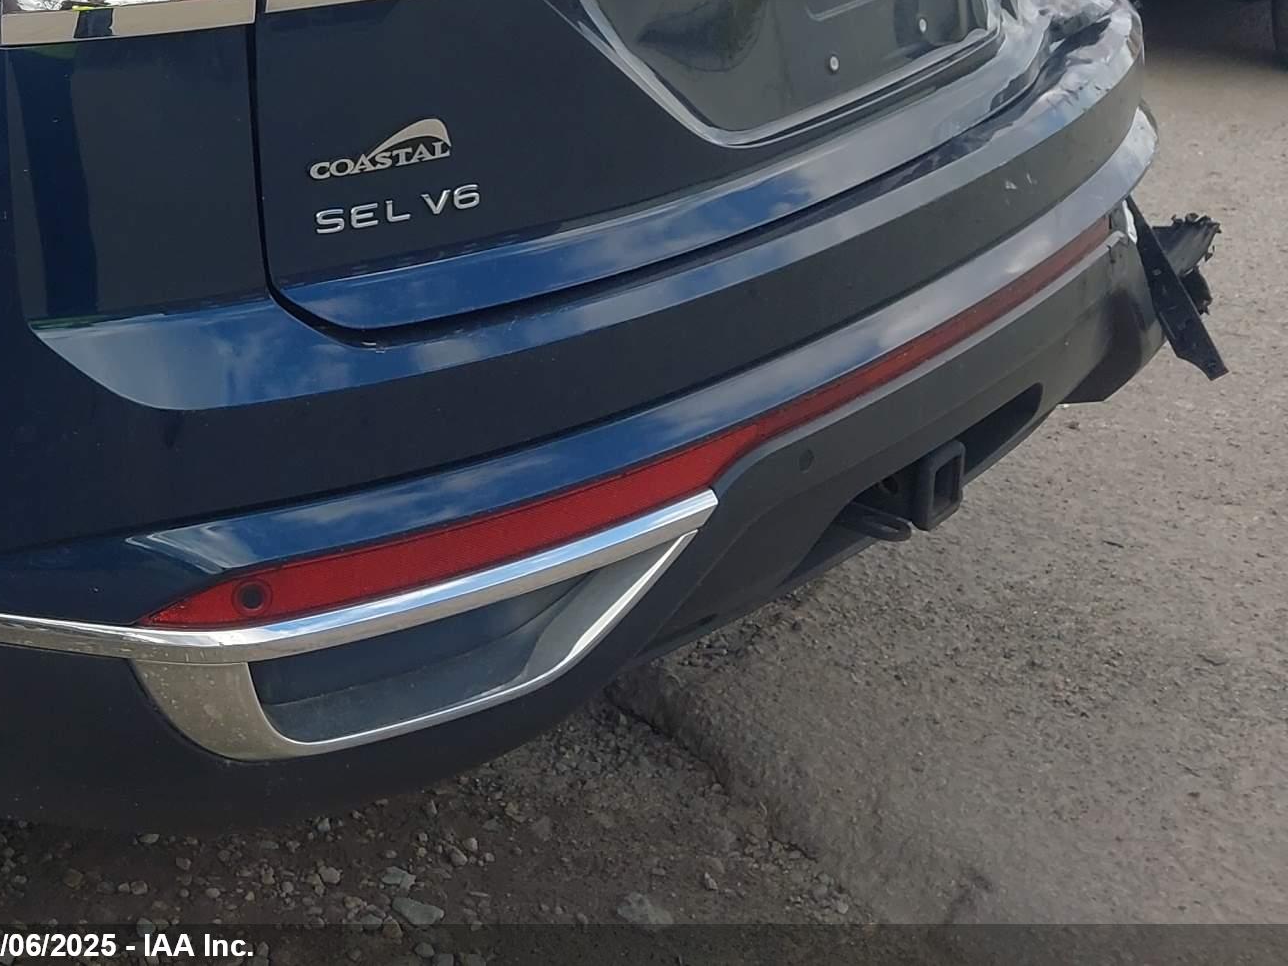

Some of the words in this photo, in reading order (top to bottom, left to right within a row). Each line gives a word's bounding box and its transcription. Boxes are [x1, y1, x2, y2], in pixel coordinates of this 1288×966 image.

[309, 139, 452, 180] COASTAL
[315, 199, 412, 234] SEL
[420, 183, 480, 215] V6
